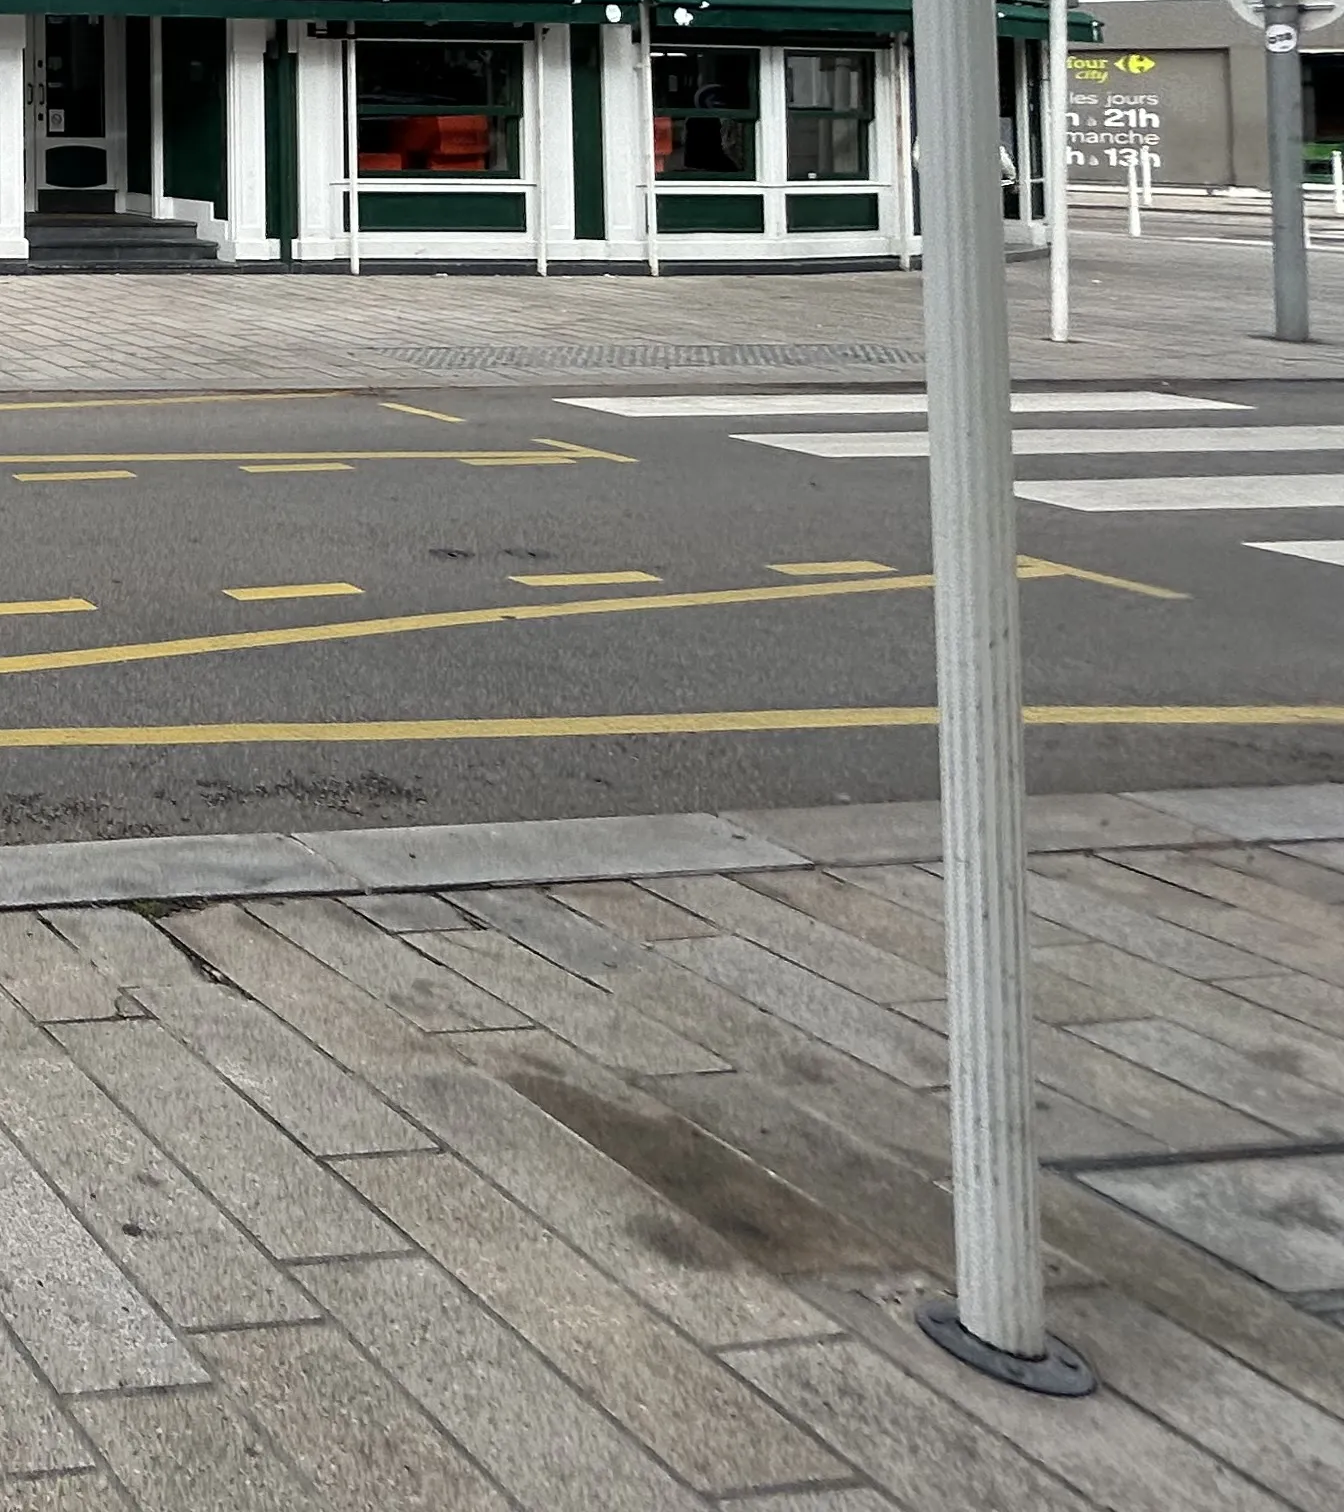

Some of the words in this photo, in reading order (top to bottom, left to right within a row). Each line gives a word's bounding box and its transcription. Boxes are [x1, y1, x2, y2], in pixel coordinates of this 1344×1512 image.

[1066, 55, 1108, 69] four
[1075, 71, 1109, 83] city
[1069, 91, 1099, 105] les
[1105, 91, 1160, 108] jours
[1104, 107, 1160, 128] 21h
[1066, 130, 1161, 145] manche
